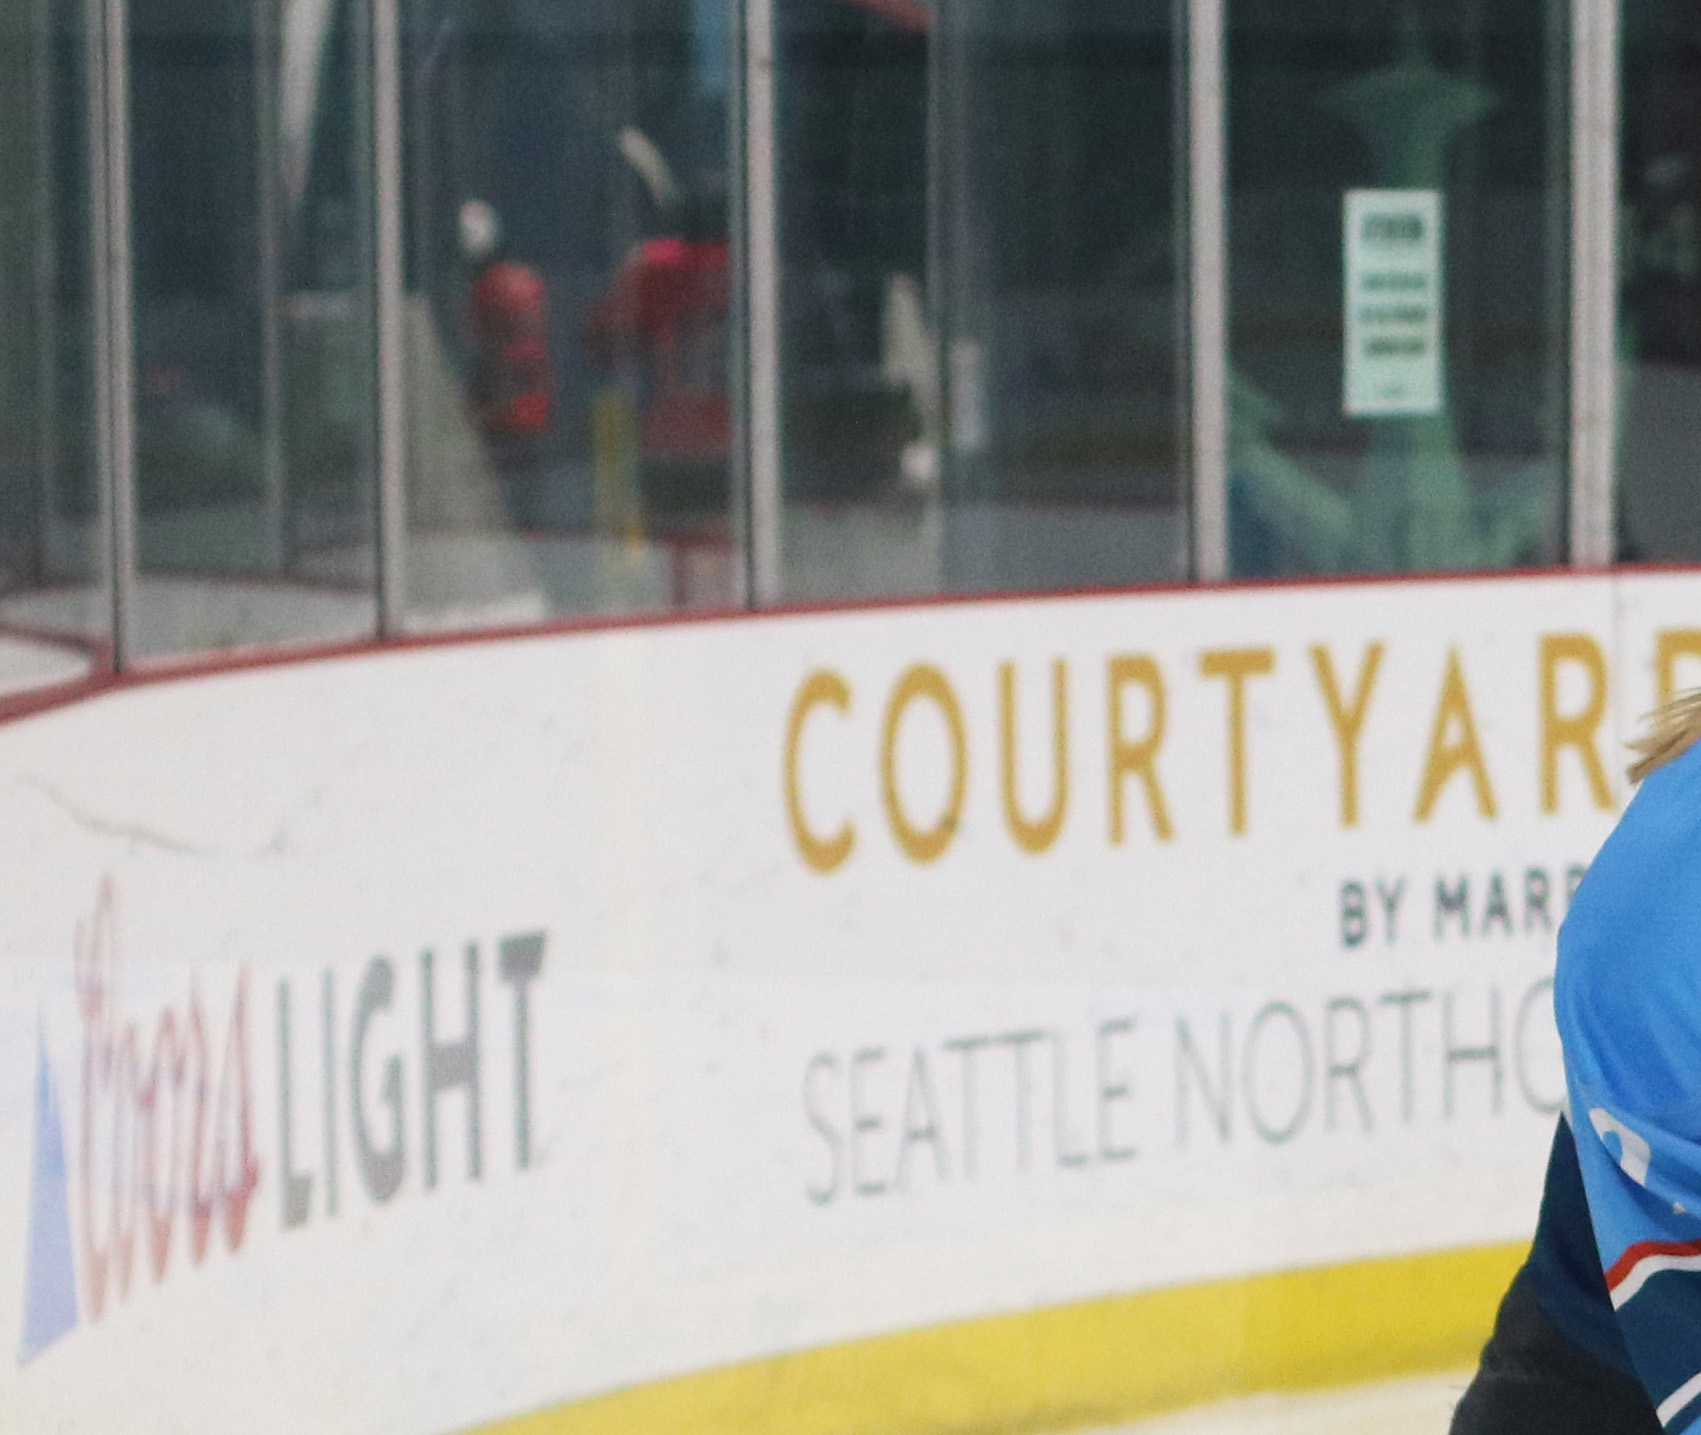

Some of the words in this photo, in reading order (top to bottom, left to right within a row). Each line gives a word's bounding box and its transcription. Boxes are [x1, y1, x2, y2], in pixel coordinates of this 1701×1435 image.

[1337, 875, 1401, 948] BY
[276, 926, 549, 1233] LIGHT
[801, 1016, 1140, 1206] SEATTLE
